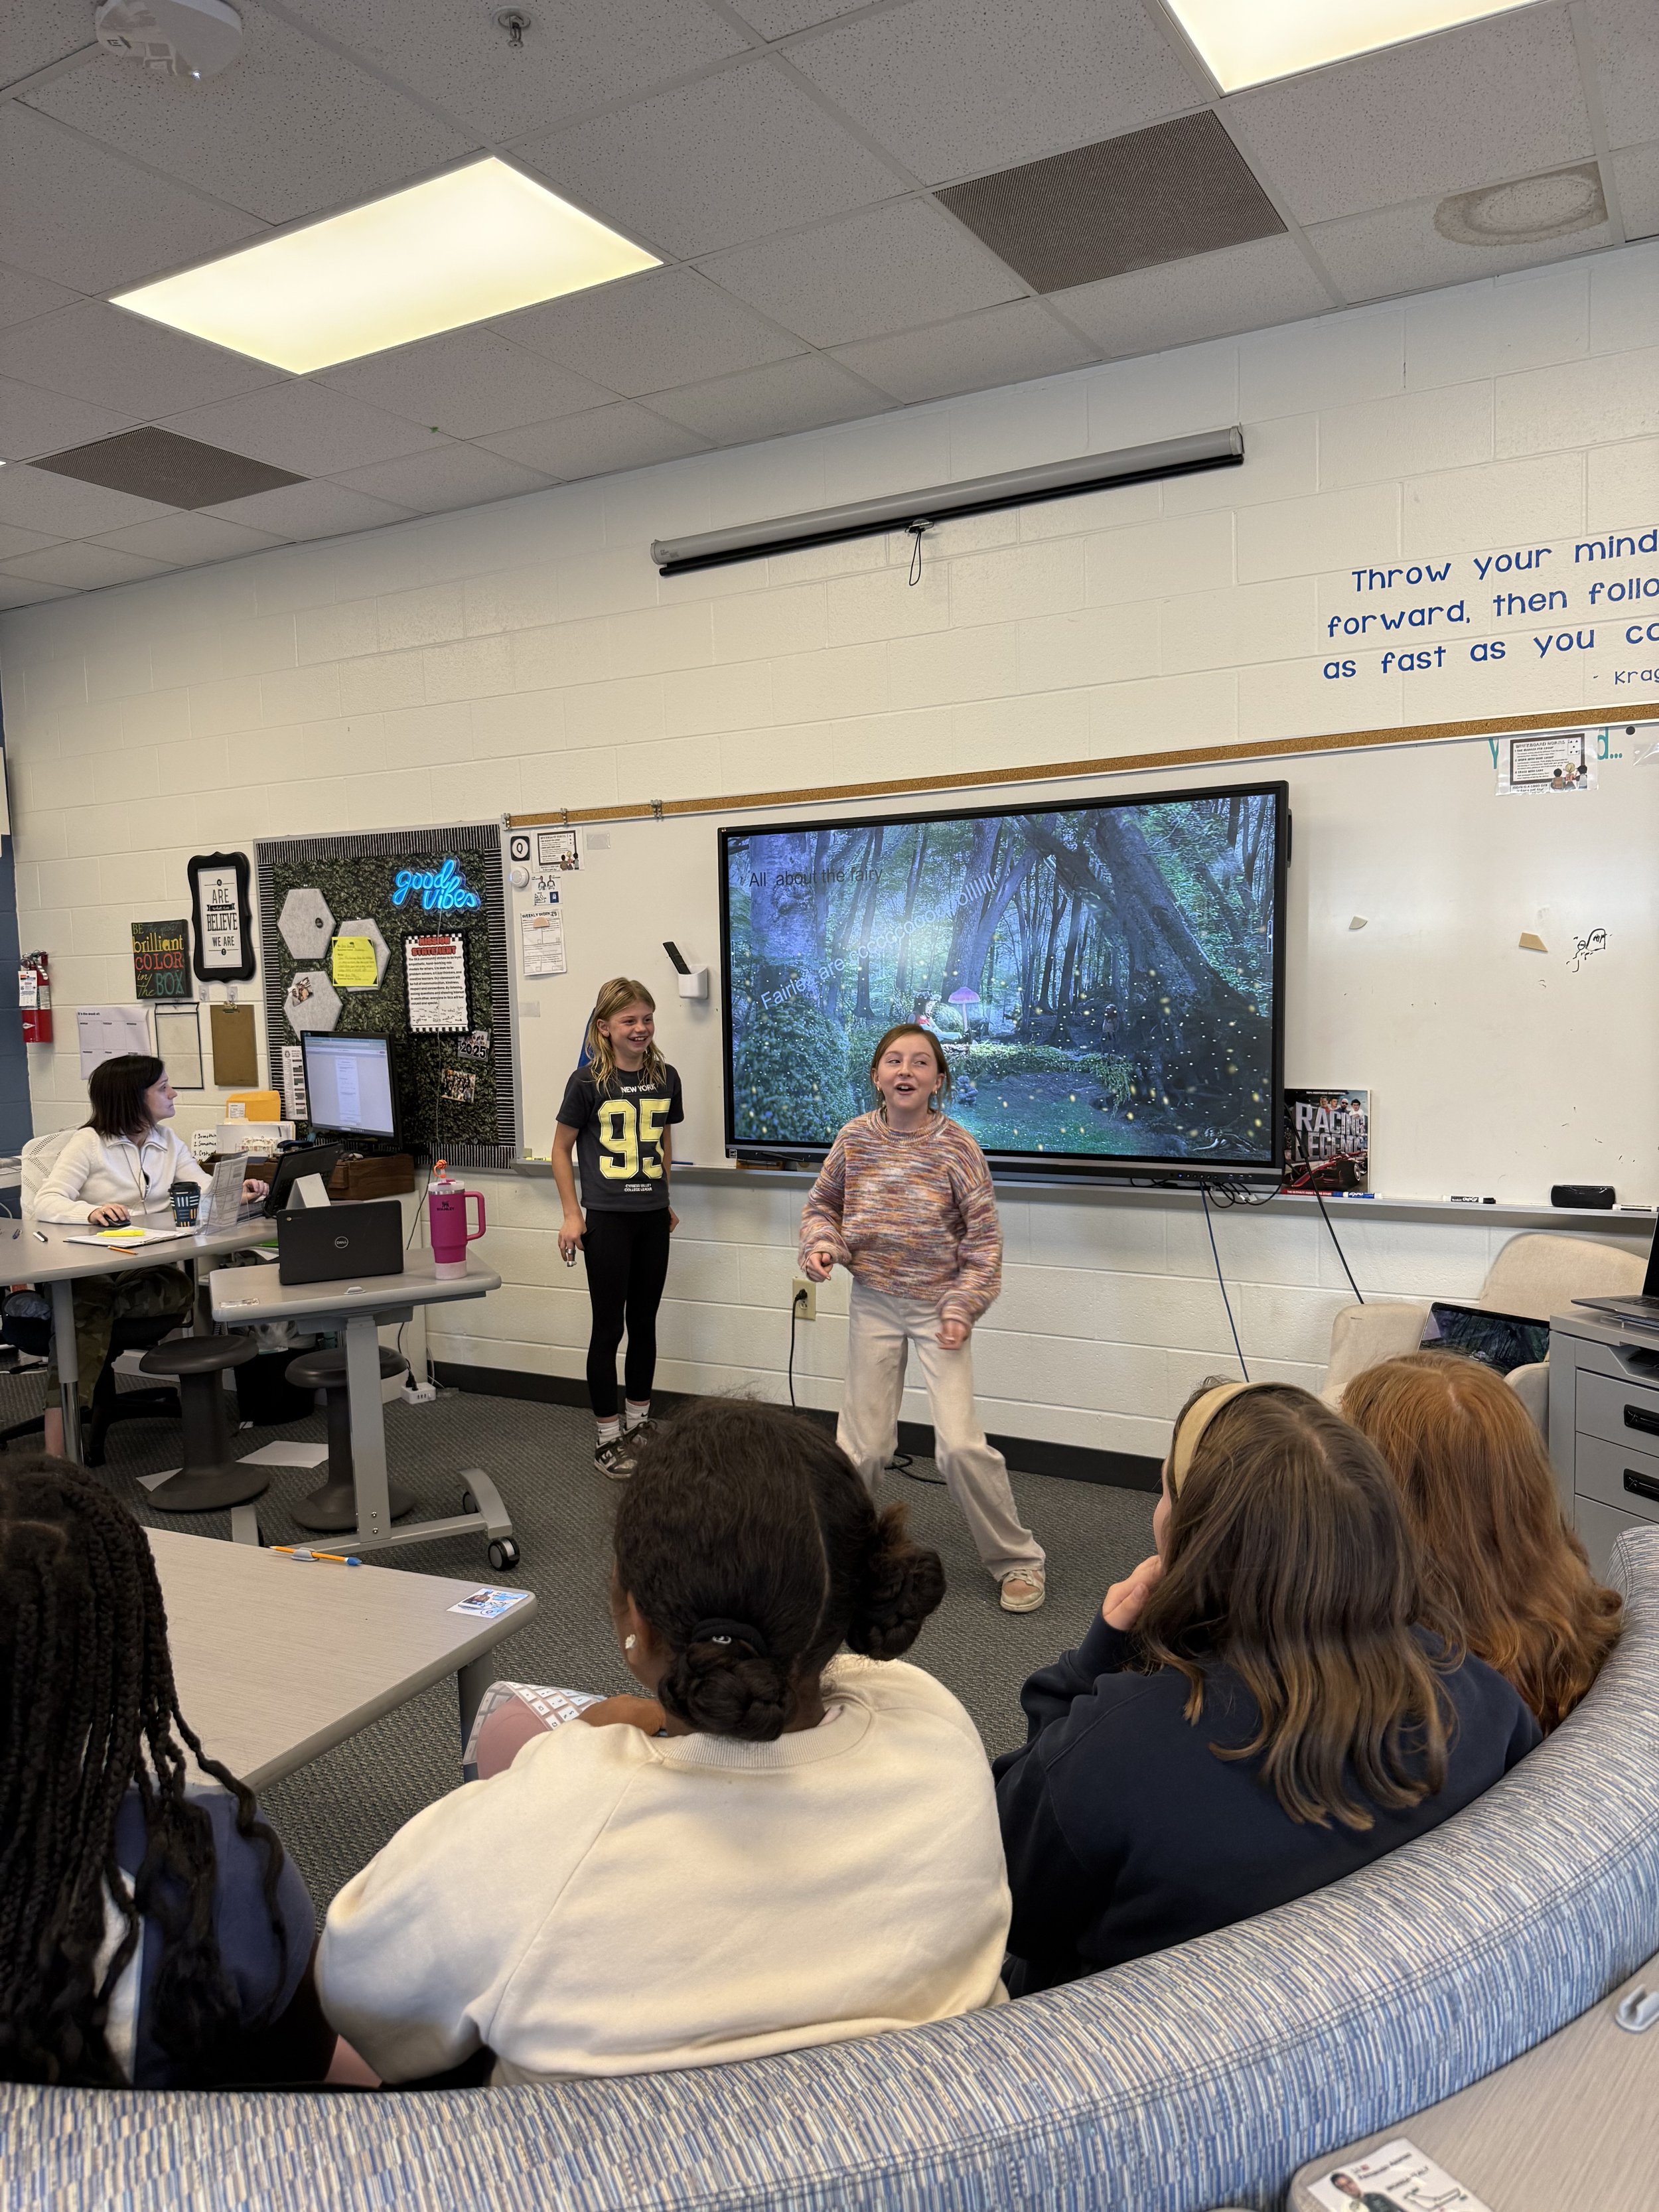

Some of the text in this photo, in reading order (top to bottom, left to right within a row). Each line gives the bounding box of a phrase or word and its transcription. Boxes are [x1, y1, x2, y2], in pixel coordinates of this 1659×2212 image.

[1352, 528, 1658, 592] Throw your mind
[1327, 600, 1471, 638] forward,
[1493, 590, 1567, 617] then
[1323, 660, 1357, 680] as
[1381, 646, 1447, 674] fast
[1470, 640, 1506, 662] as
[1533, 629, 1595, 659] you
[516, 842, 523, 854] Q
[392, 859, 455, 906] good
[749, 867, 883, 887] All about the fairy
[212, 888, 230, 904] ARE
[422, 875, 476, 910] vibes
[133, 923, 144, 935] BE
[206, 913, 238, 931] BELIEVE
[133, 932, 184, 953] brilliant
[212, 936, 235, 946] WE ARE
[411, 945, 457, 956] STATEMENT
[418, 937, 451, 946] MISSION
[137, 971, 149, 981] in
[818, 958, 845, 980] are
[155, 972, 185, 996] BOX
[461, 1041, 486, 1059] 2025
[637, 1084, 656, 1093] YORK
[1295, 1101, 1366, 1136] RACING
[598, 1098, 672, 1179] 95
[1295, 1131, 1366, 1162] LEGENDS
